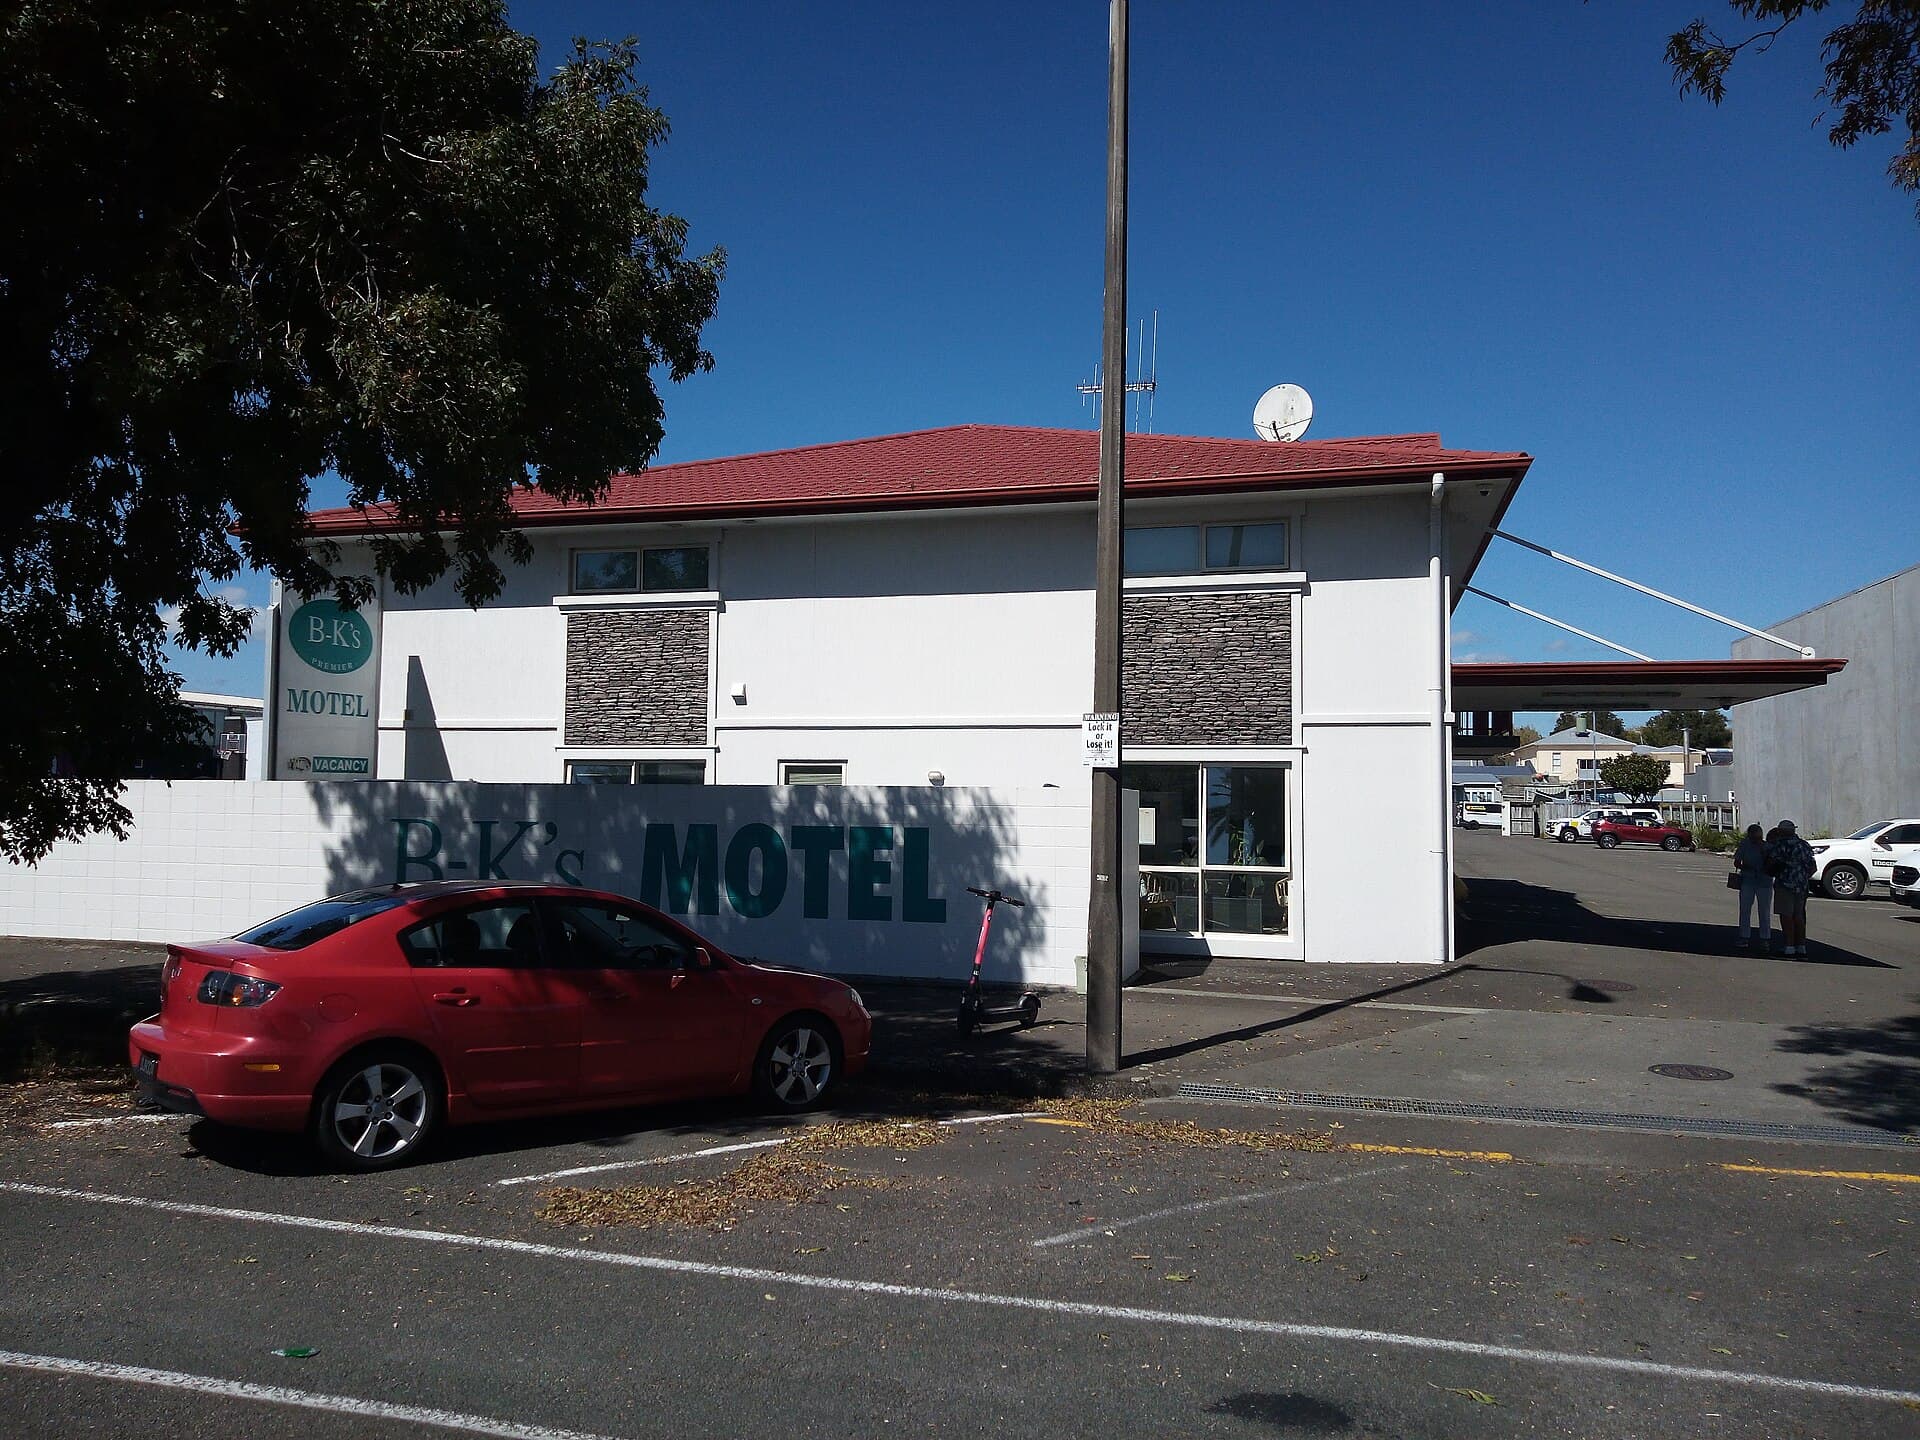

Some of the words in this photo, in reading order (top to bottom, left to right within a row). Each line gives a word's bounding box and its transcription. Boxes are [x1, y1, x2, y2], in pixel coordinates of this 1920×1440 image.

[307, 615, 361, 649] B-K's
[311, 656, 353, 670] PREMIER
[286, 688, 369, 718] MOTEL
[1088, 722, 1105, 731] Lock
[1106, 722, 1112, 731] it
[1086, 739, 1103, 748] Lose
[1104, 739, 1113, 748] it!
[314, 759, 367, 771] VACANCY
[391, 818, 585, 887] B-K's
[640, 821, 947, 924] MOTEL
